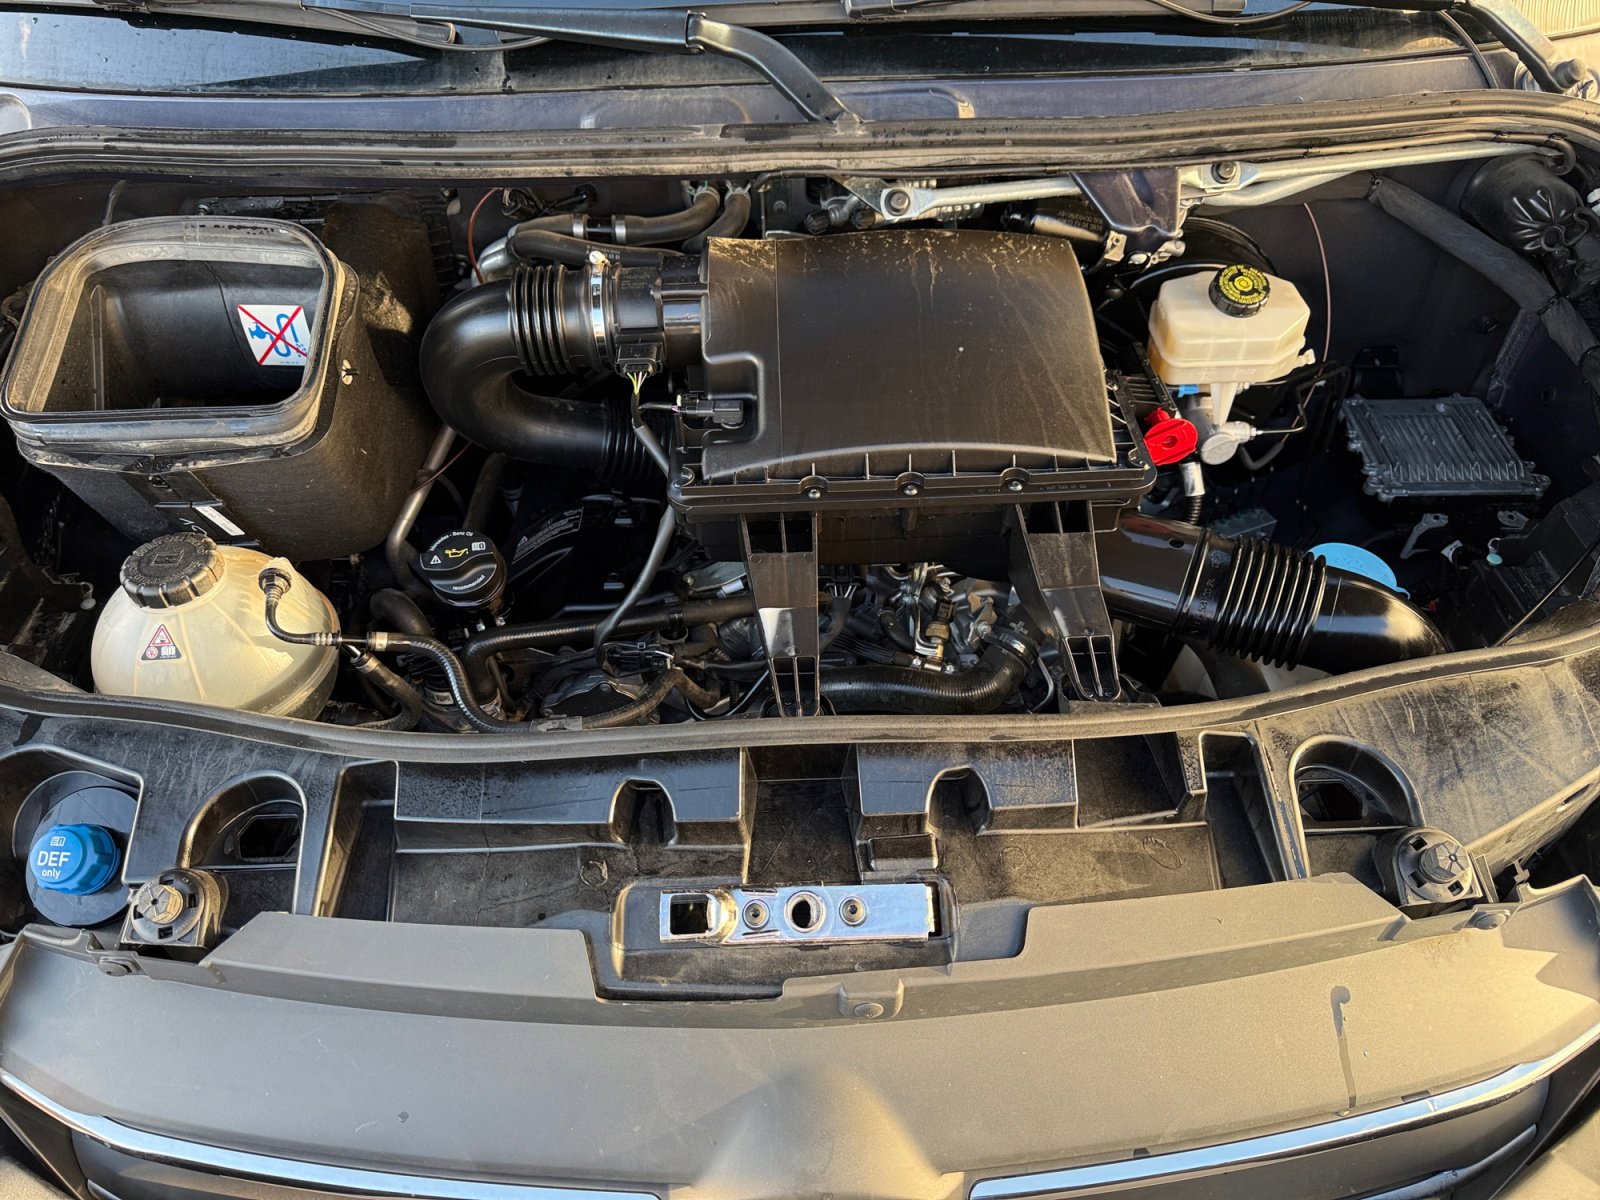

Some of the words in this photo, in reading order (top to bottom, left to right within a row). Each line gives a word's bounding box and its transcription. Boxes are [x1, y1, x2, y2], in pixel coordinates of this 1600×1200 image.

[452, 574, 485, 591] recommended
[37, 850, 71, 867] DEF
[41, 868, 61, 880] only
